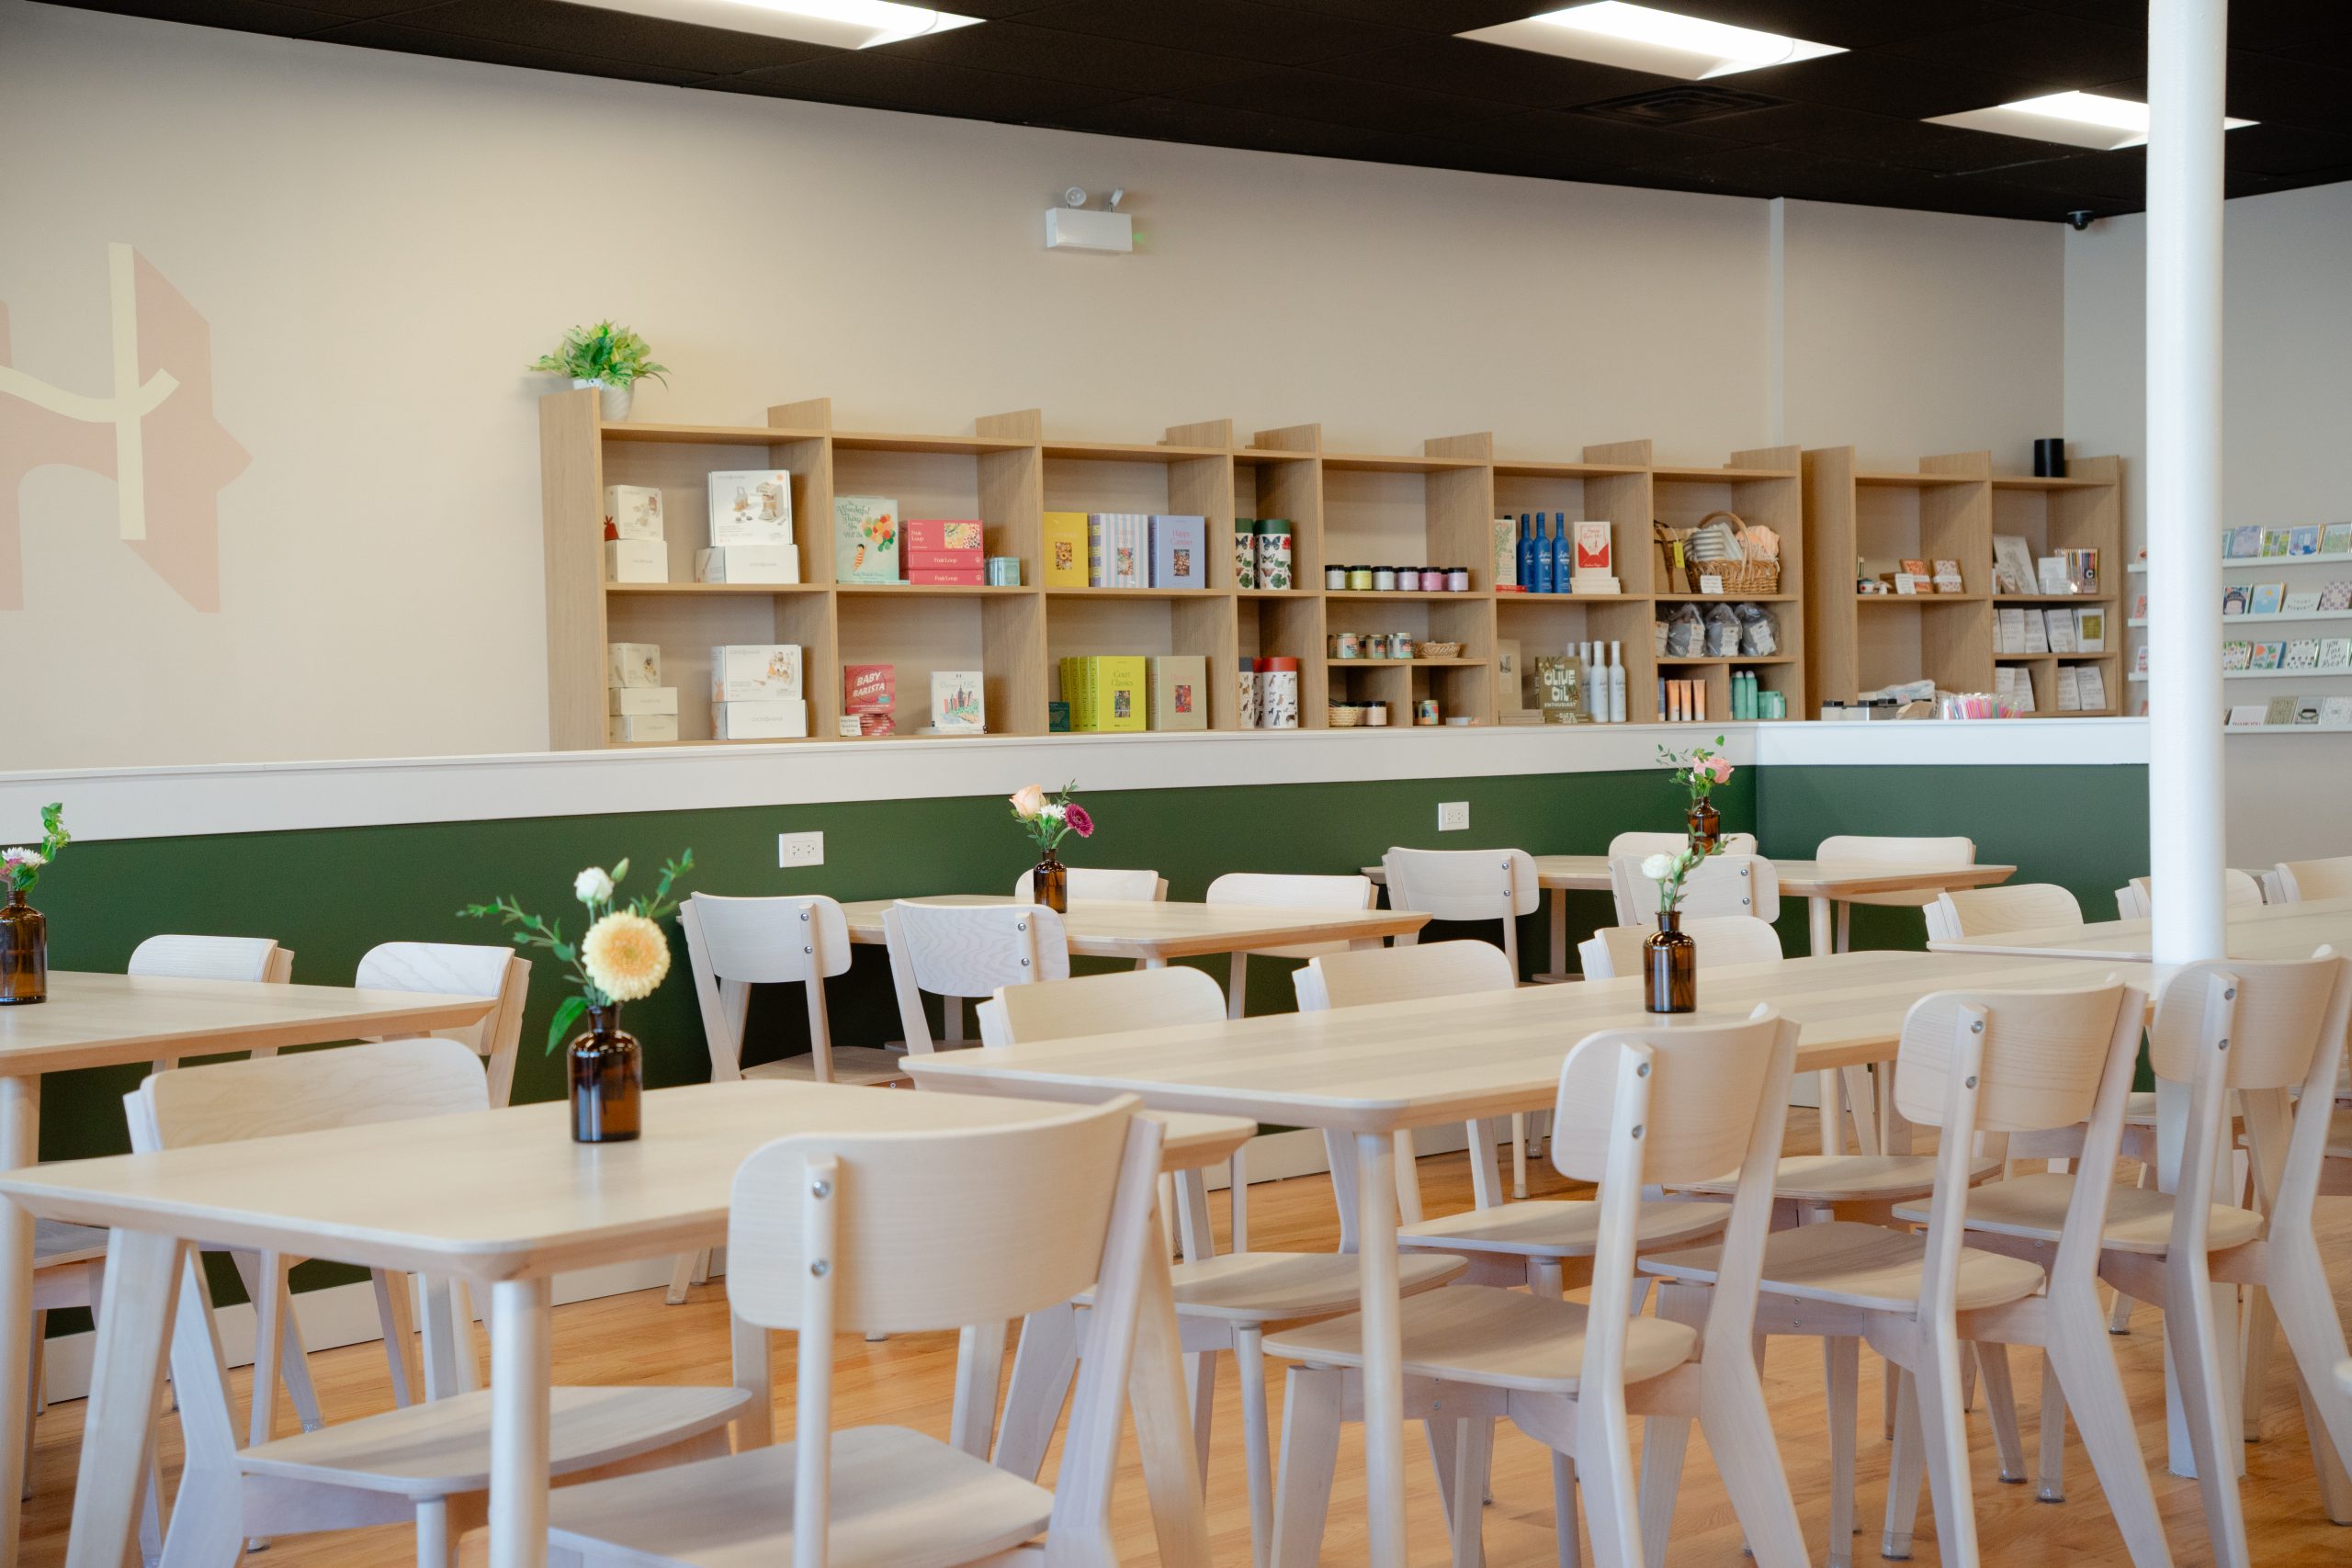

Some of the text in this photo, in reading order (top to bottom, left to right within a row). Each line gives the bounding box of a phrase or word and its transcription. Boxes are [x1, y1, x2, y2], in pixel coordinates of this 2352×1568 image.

[837, 505, 870, 515] Wonderful
[856, 671, 882, 686] BABY
[1544, 669, 1576, 686] OLIVE
[853, 682, 886, 697] BARISTA
[1552, 685, 1569, 701] OIL
